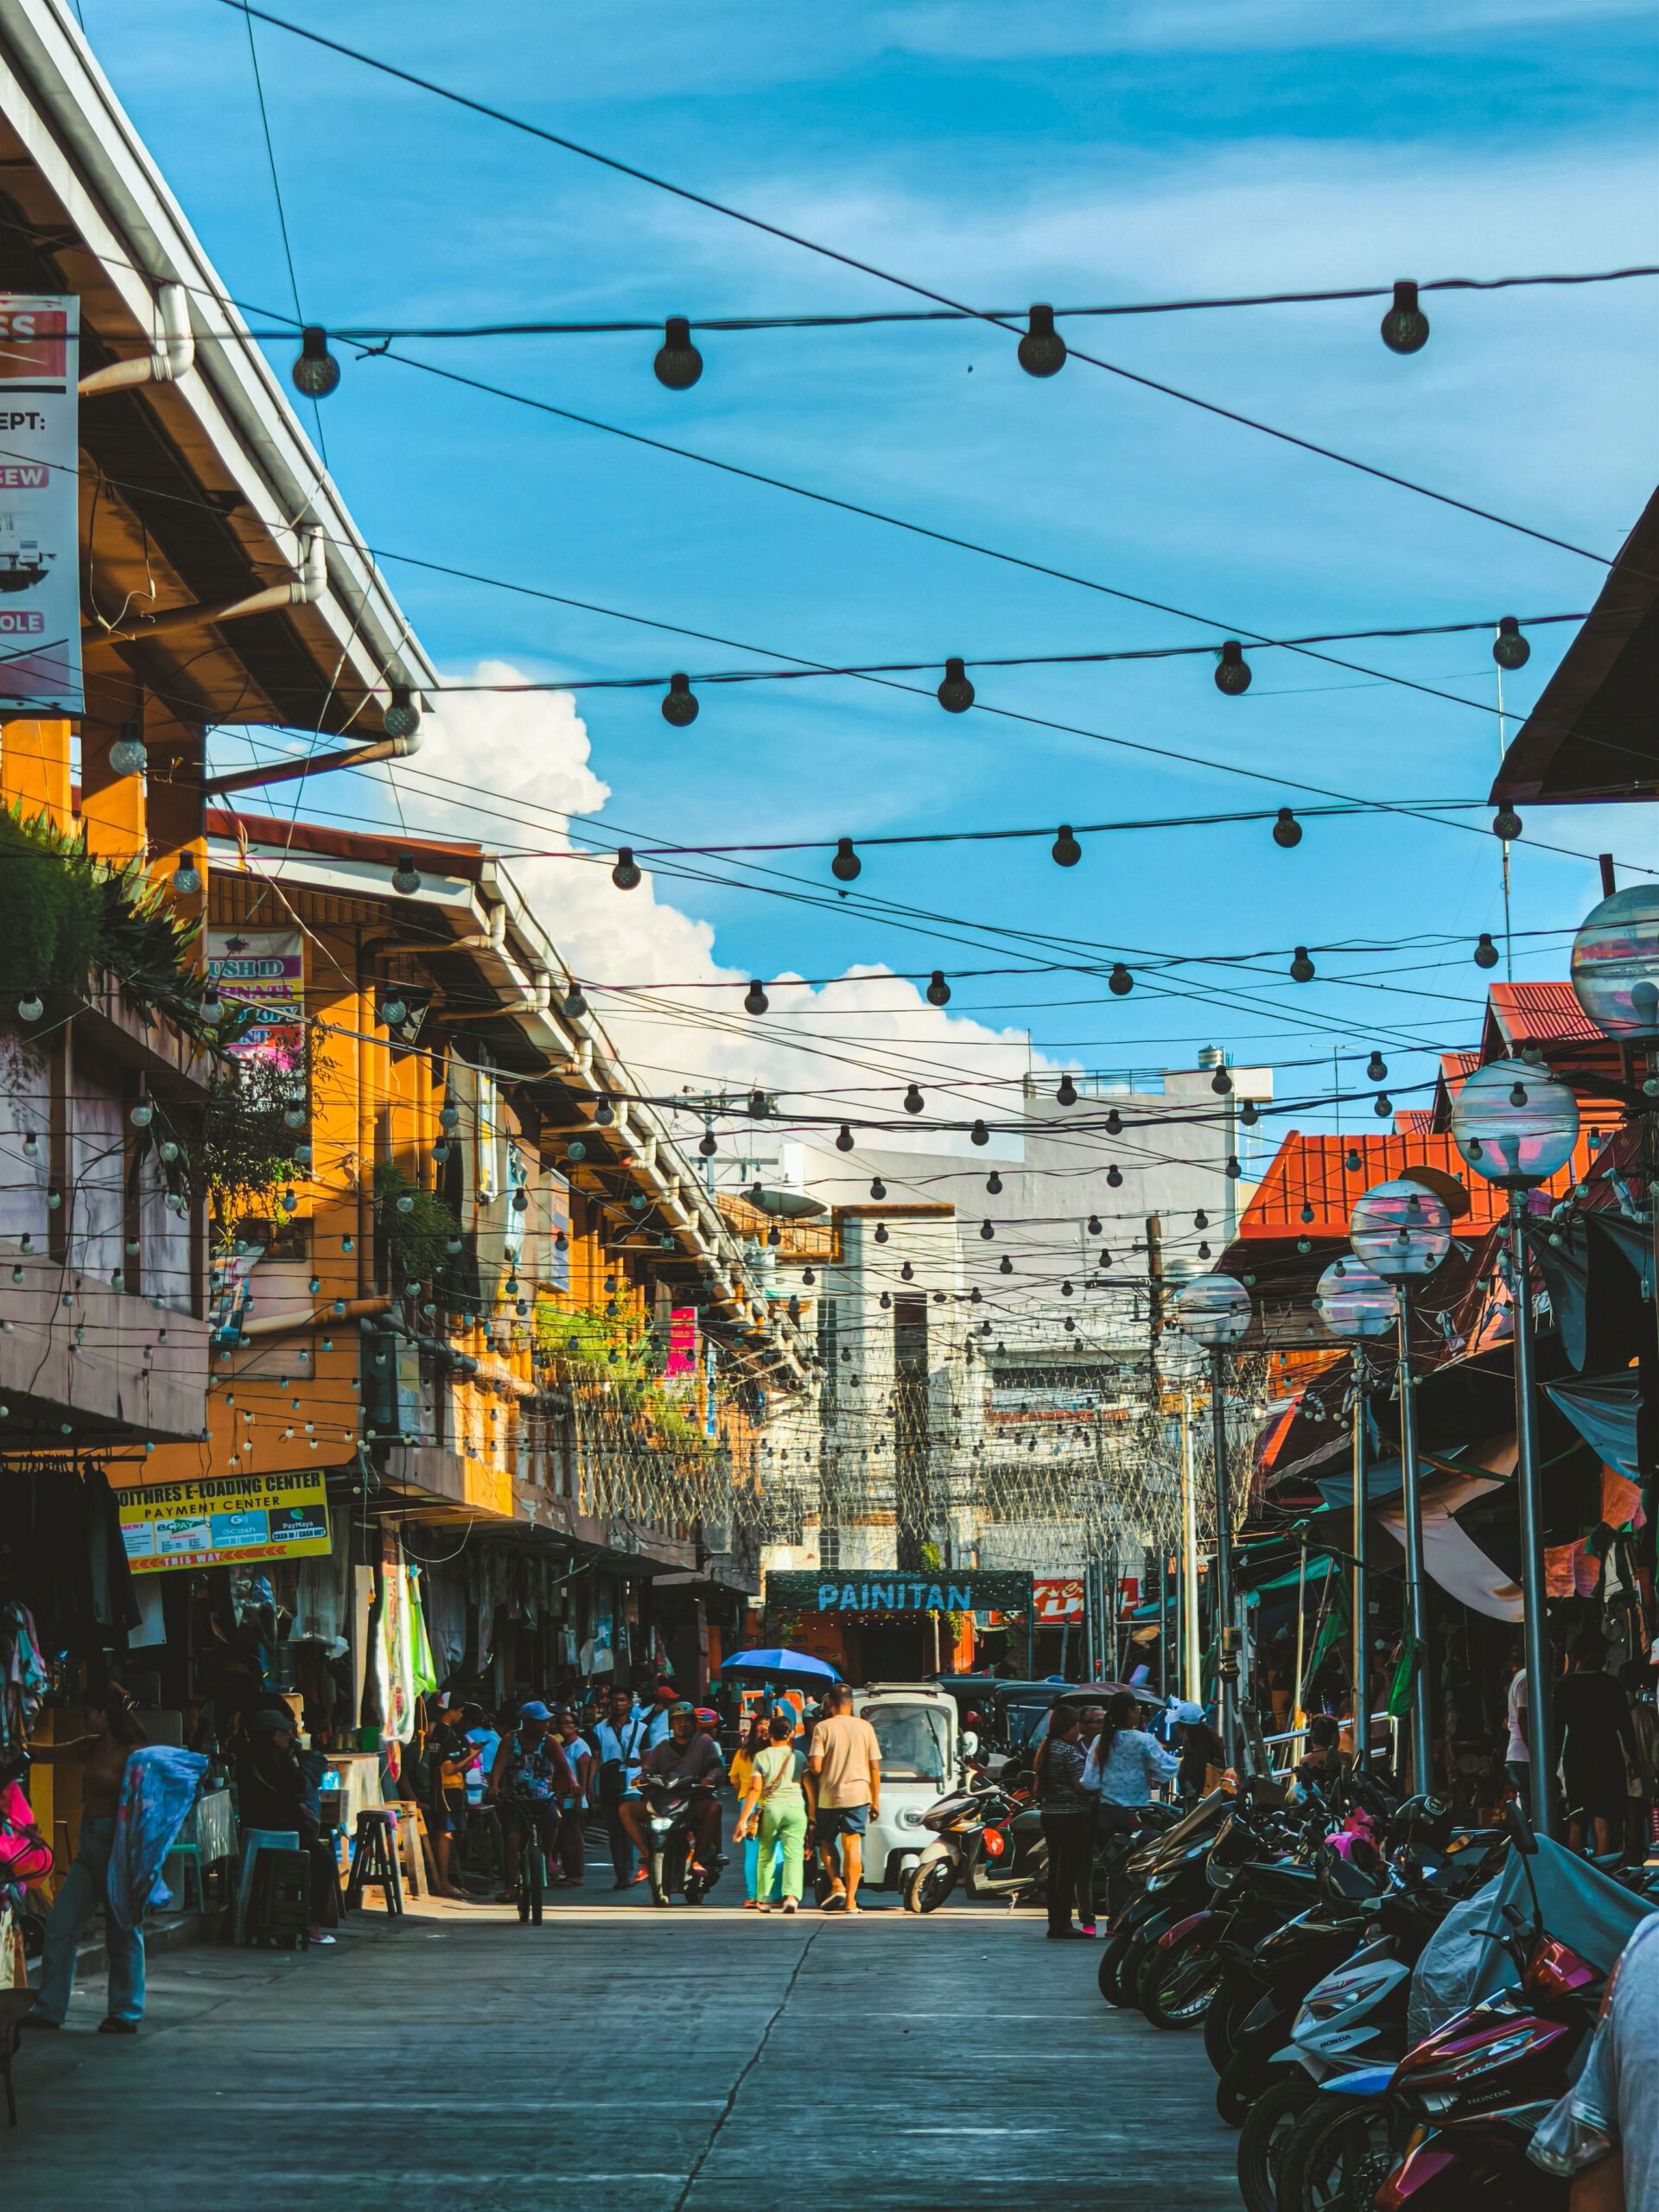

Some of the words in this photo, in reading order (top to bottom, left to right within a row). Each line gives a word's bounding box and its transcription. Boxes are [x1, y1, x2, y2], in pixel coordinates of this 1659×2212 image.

[0, 614, 41, 631] OLE
[257, 960, 284, 977] ID
[237, 1029, 271, 1044] NT
[118, 1486, 182, 1508] OITHRES
[185, 1478, 262, 1502] E-LOADING
[265, 1471, 321, 1491] CENTER
[144, 1502, 215, 1519] PAYMENT
[223, 1497, 280, 1511] CENTER
[164, 1555, 192, 1567] THIS
[195, 1553, 220, 1564] WAY
[817, 1583, 971, 1611] PAINITAN
[1319, 2035, 1352, 2049] HONDA
[1466, 2089, 1511, 2105] HONDA
